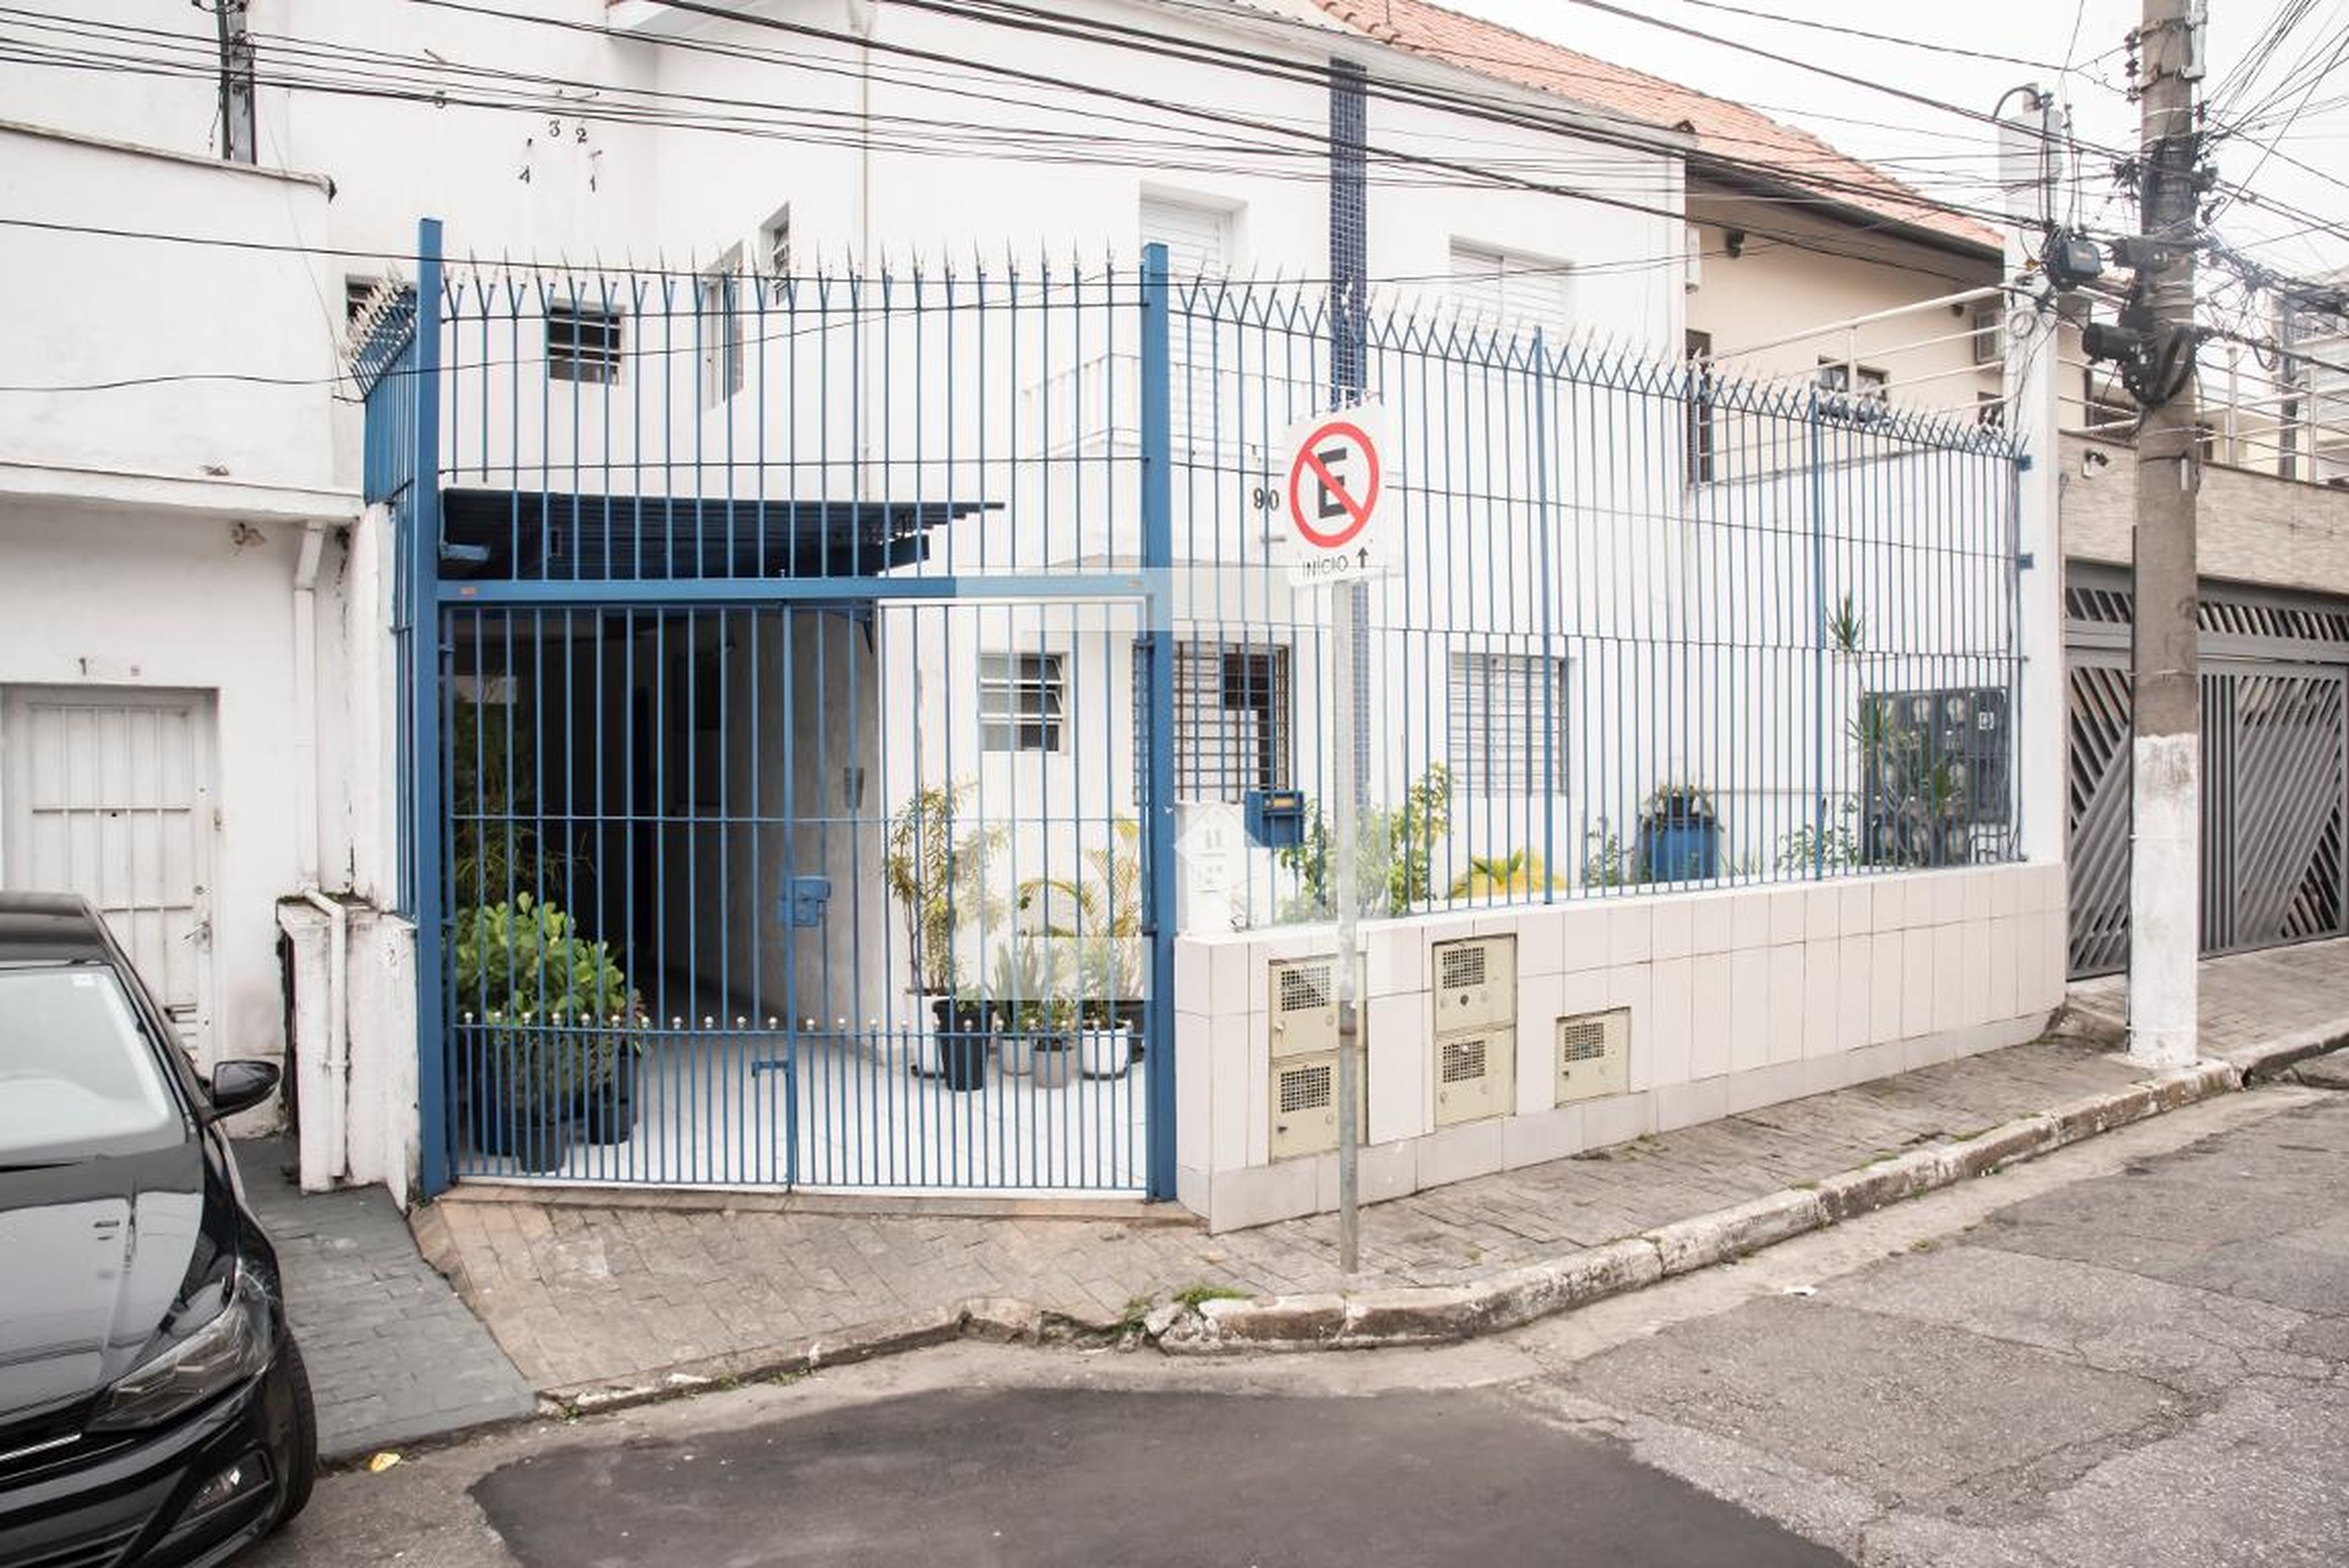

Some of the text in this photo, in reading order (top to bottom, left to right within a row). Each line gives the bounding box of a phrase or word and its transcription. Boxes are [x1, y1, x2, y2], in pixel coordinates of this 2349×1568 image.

[549, 119, 560, 138] 3
[576, 127, 587, 144] 2
[519, 165, 530, 184] 4
[1318, 447, 1348, 519] E
